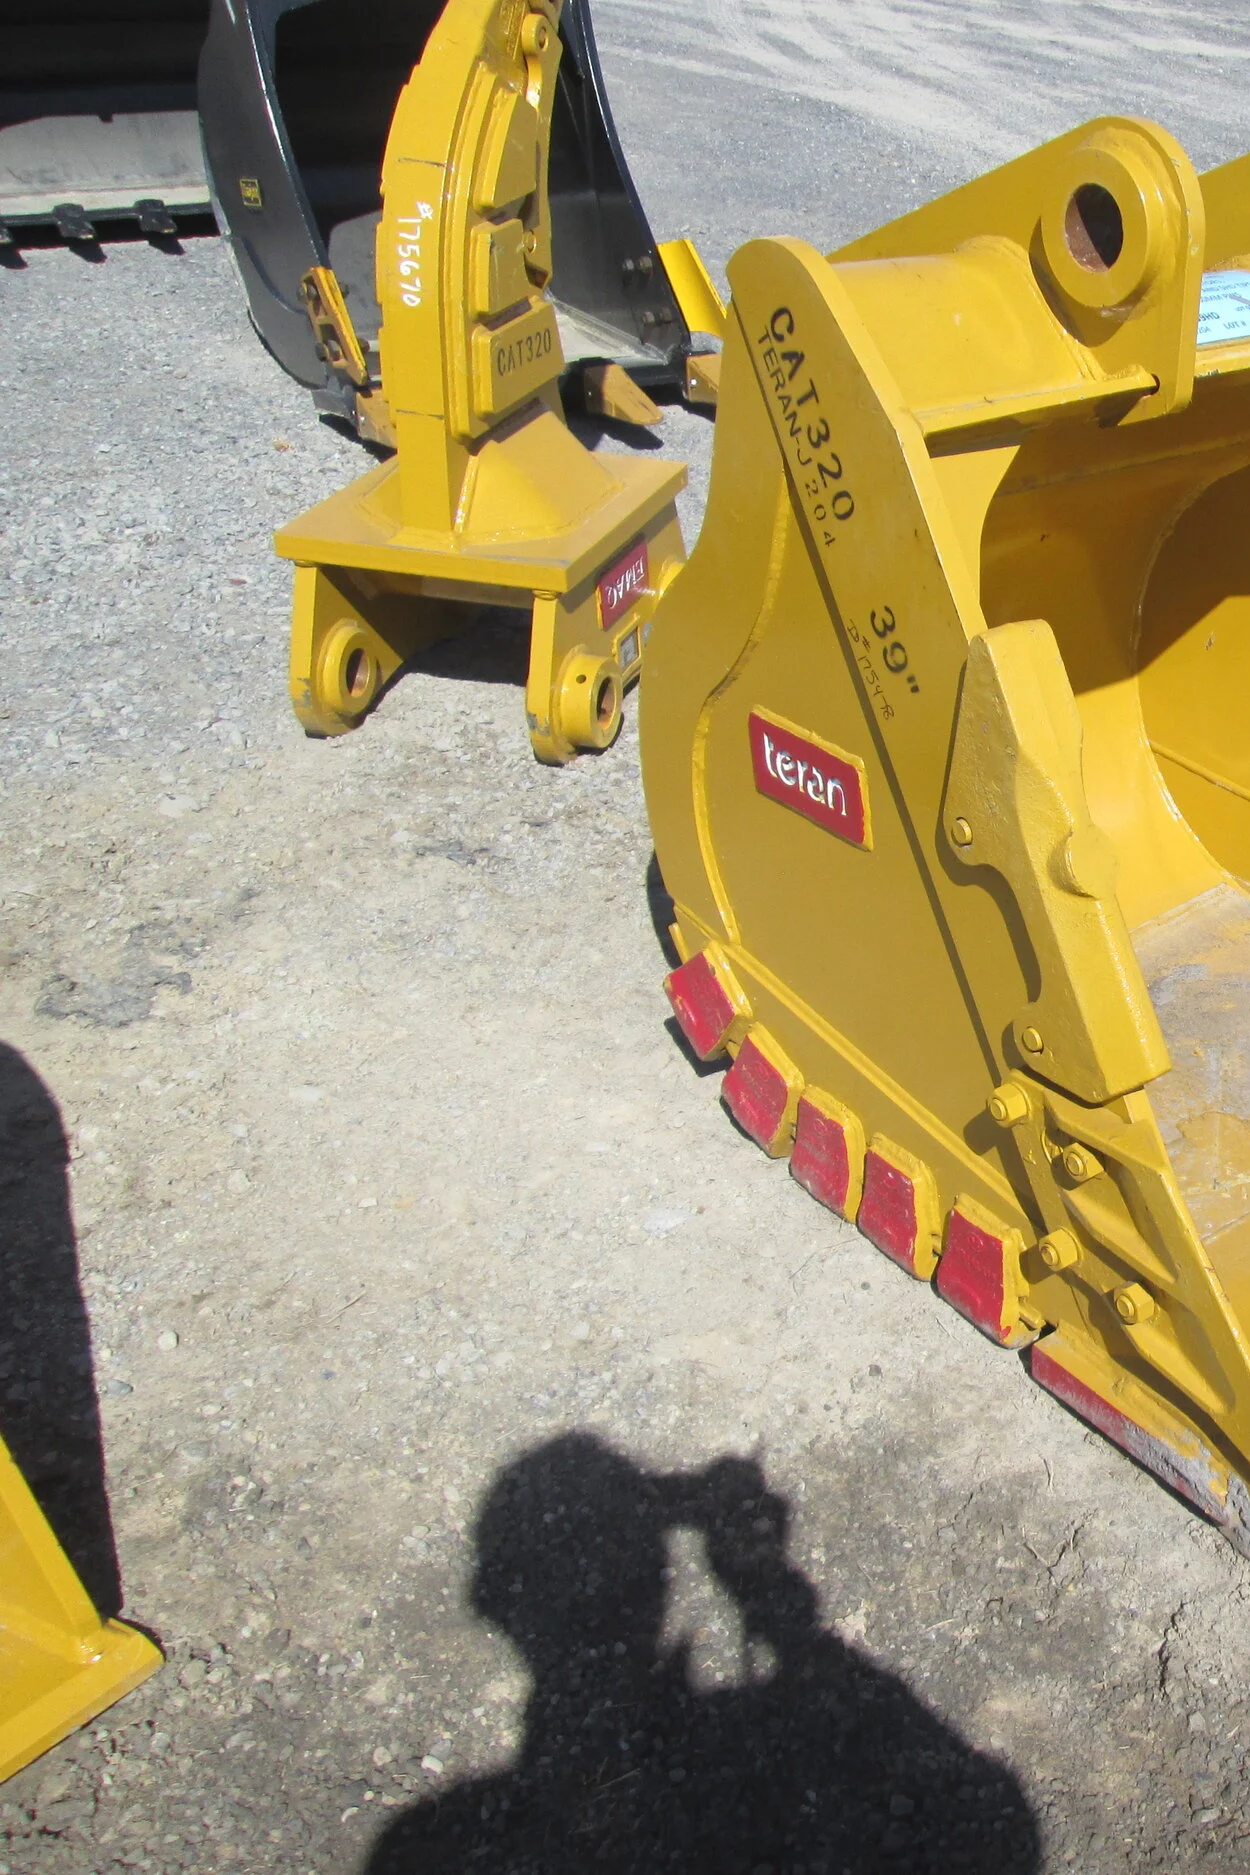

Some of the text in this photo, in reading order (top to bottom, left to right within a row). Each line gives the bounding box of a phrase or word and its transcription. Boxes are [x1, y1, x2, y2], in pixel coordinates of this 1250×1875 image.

[397, 200, 434, 307] #175670
[497, 328, 551, 377] CAT320
[870, 605, 920, 694] 39"
[763, 732, 847, 816] teran
